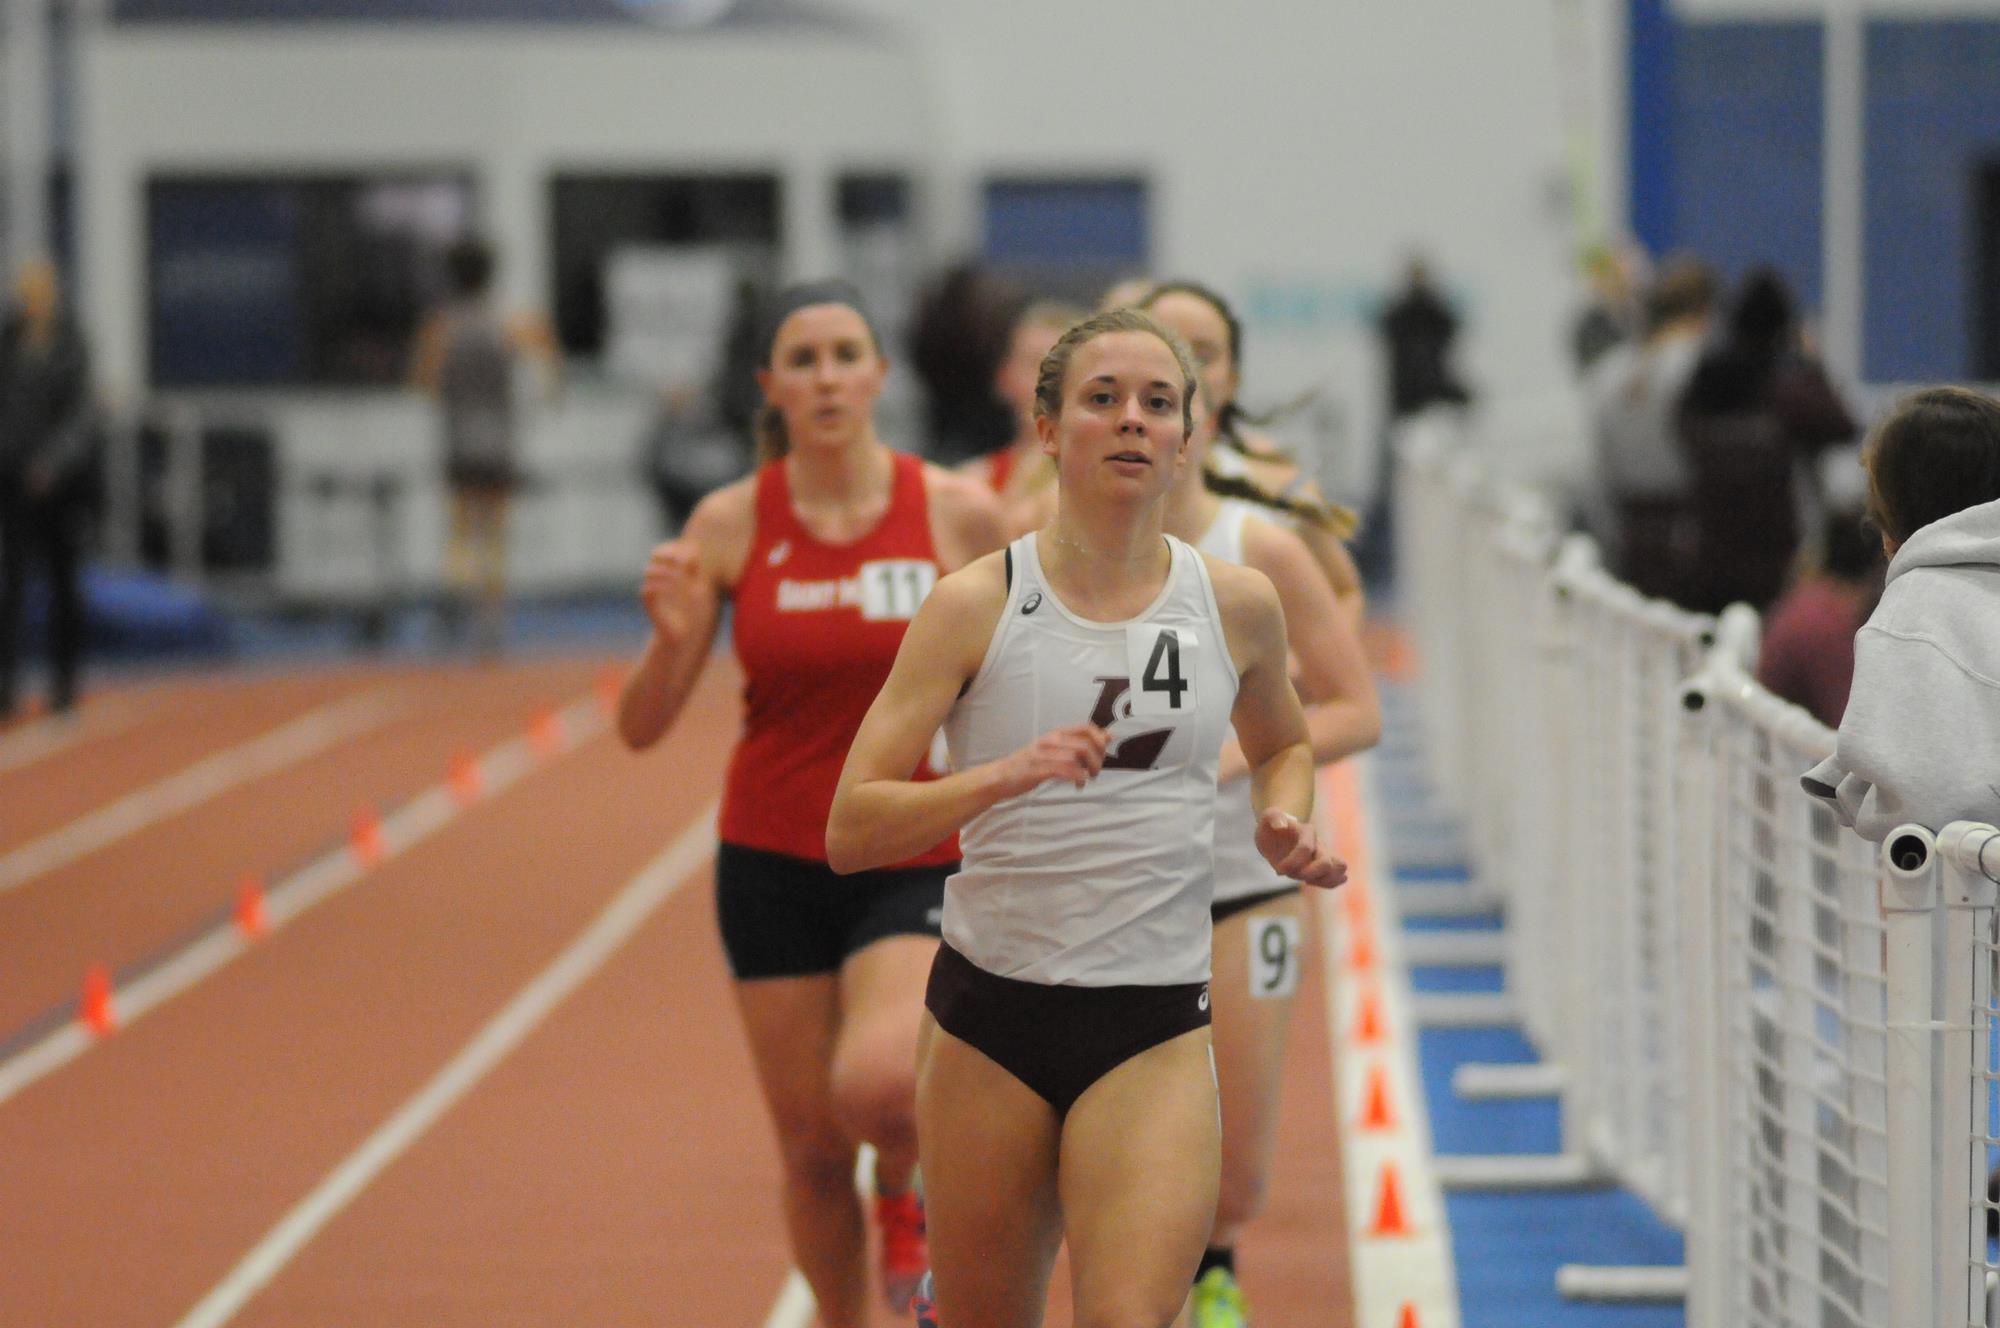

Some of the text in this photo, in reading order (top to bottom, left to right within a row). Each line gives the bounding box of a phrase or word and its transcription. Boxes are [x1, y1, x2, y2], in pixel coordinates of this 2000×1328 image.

[880, 568, 921, 613] 11
[1142, 628, 1188, 709] 4
[1260, 923, 1287, 991] 9
